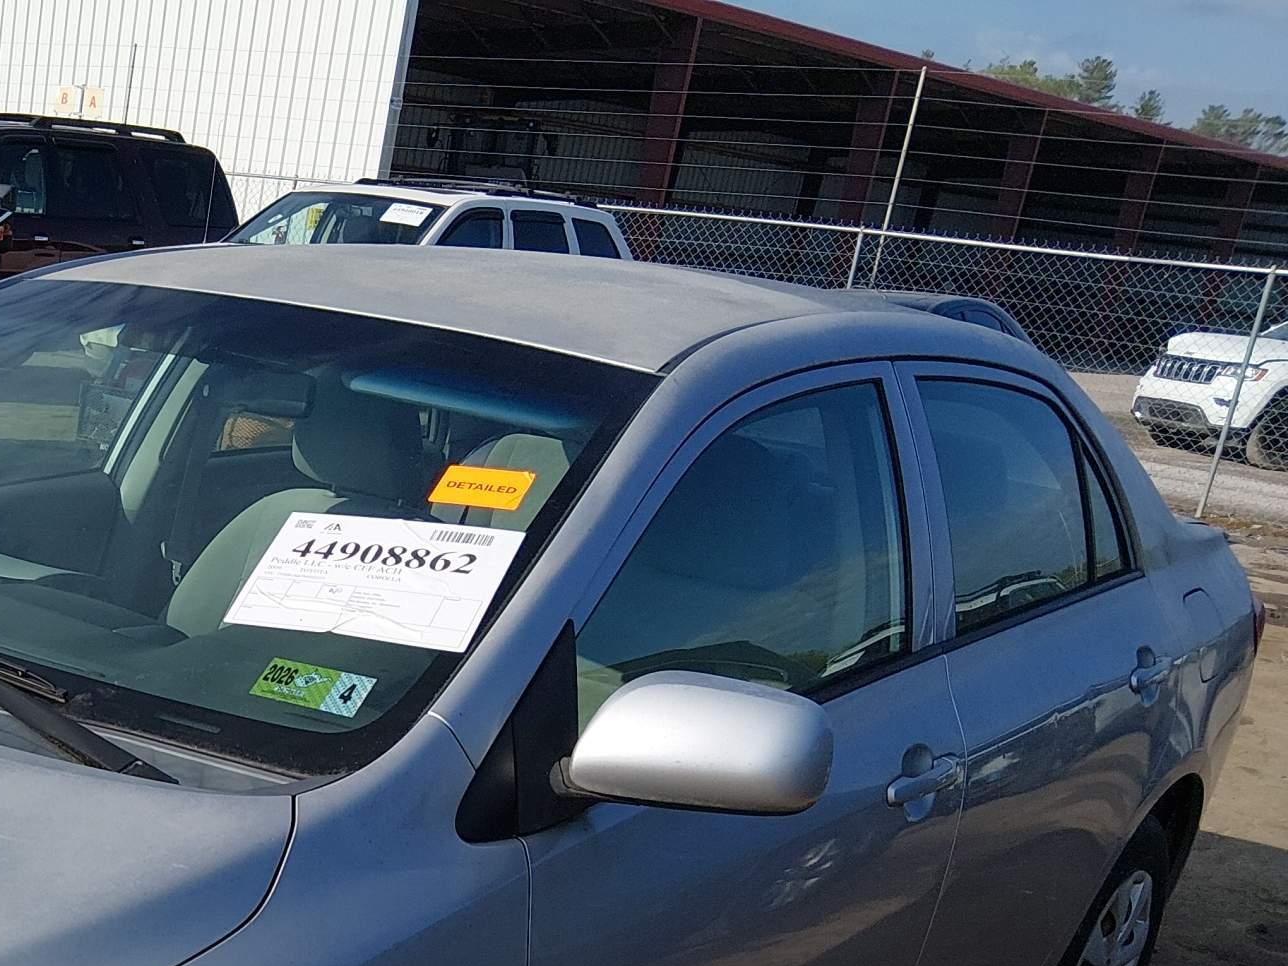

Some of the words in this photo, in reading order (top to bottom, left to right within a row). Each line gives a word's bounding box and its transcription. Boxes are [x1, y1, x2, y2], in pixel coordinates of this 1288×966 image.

[61, 92, 68, 105] B
[89, 95, 97, 108] A
[446, 480, 518, 494] DETAILED
[292, 538, 478, 575] 44908862
[262, 663, 299, 686] 2026
[338, 683, 358, 704] 4
